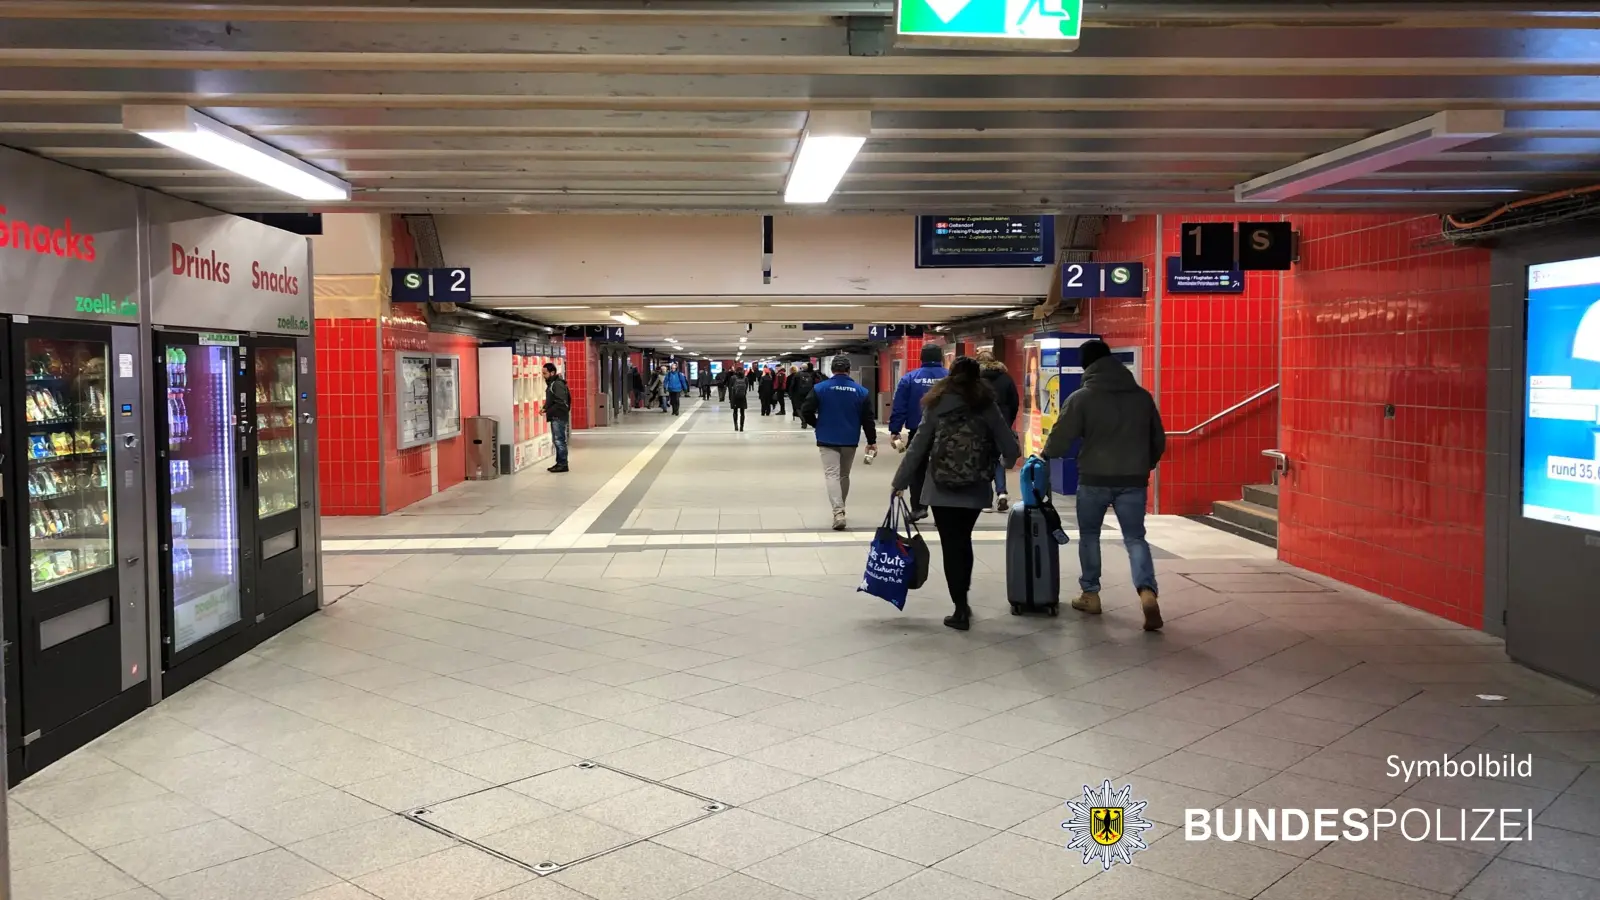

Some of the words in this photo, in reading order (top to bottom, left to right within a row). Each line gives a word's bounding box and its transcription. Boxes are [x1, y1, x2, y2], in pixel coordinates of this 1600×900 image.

[1188, 226, 1202, 256] 1
[1252, 230, 1270, 250] S
[172, 242, 230, 284] Drinks
[252, 260, 298, 295] Snacks
[1067, 264, 1083, 287] 2
[1113, 268, 1128, 283] S
[406, 273, 420, 288] S
[451, 270, 466, 291] 2
[278, 315, 309, 331] zoells.de
[615, 327, 623, 338] 4
[870, 326, 878, 337] 4
[1551, 463, 1576, 477] rund
[880, 552, 906, 568] Jute
[874, 563, 904, 576] Zukunft
